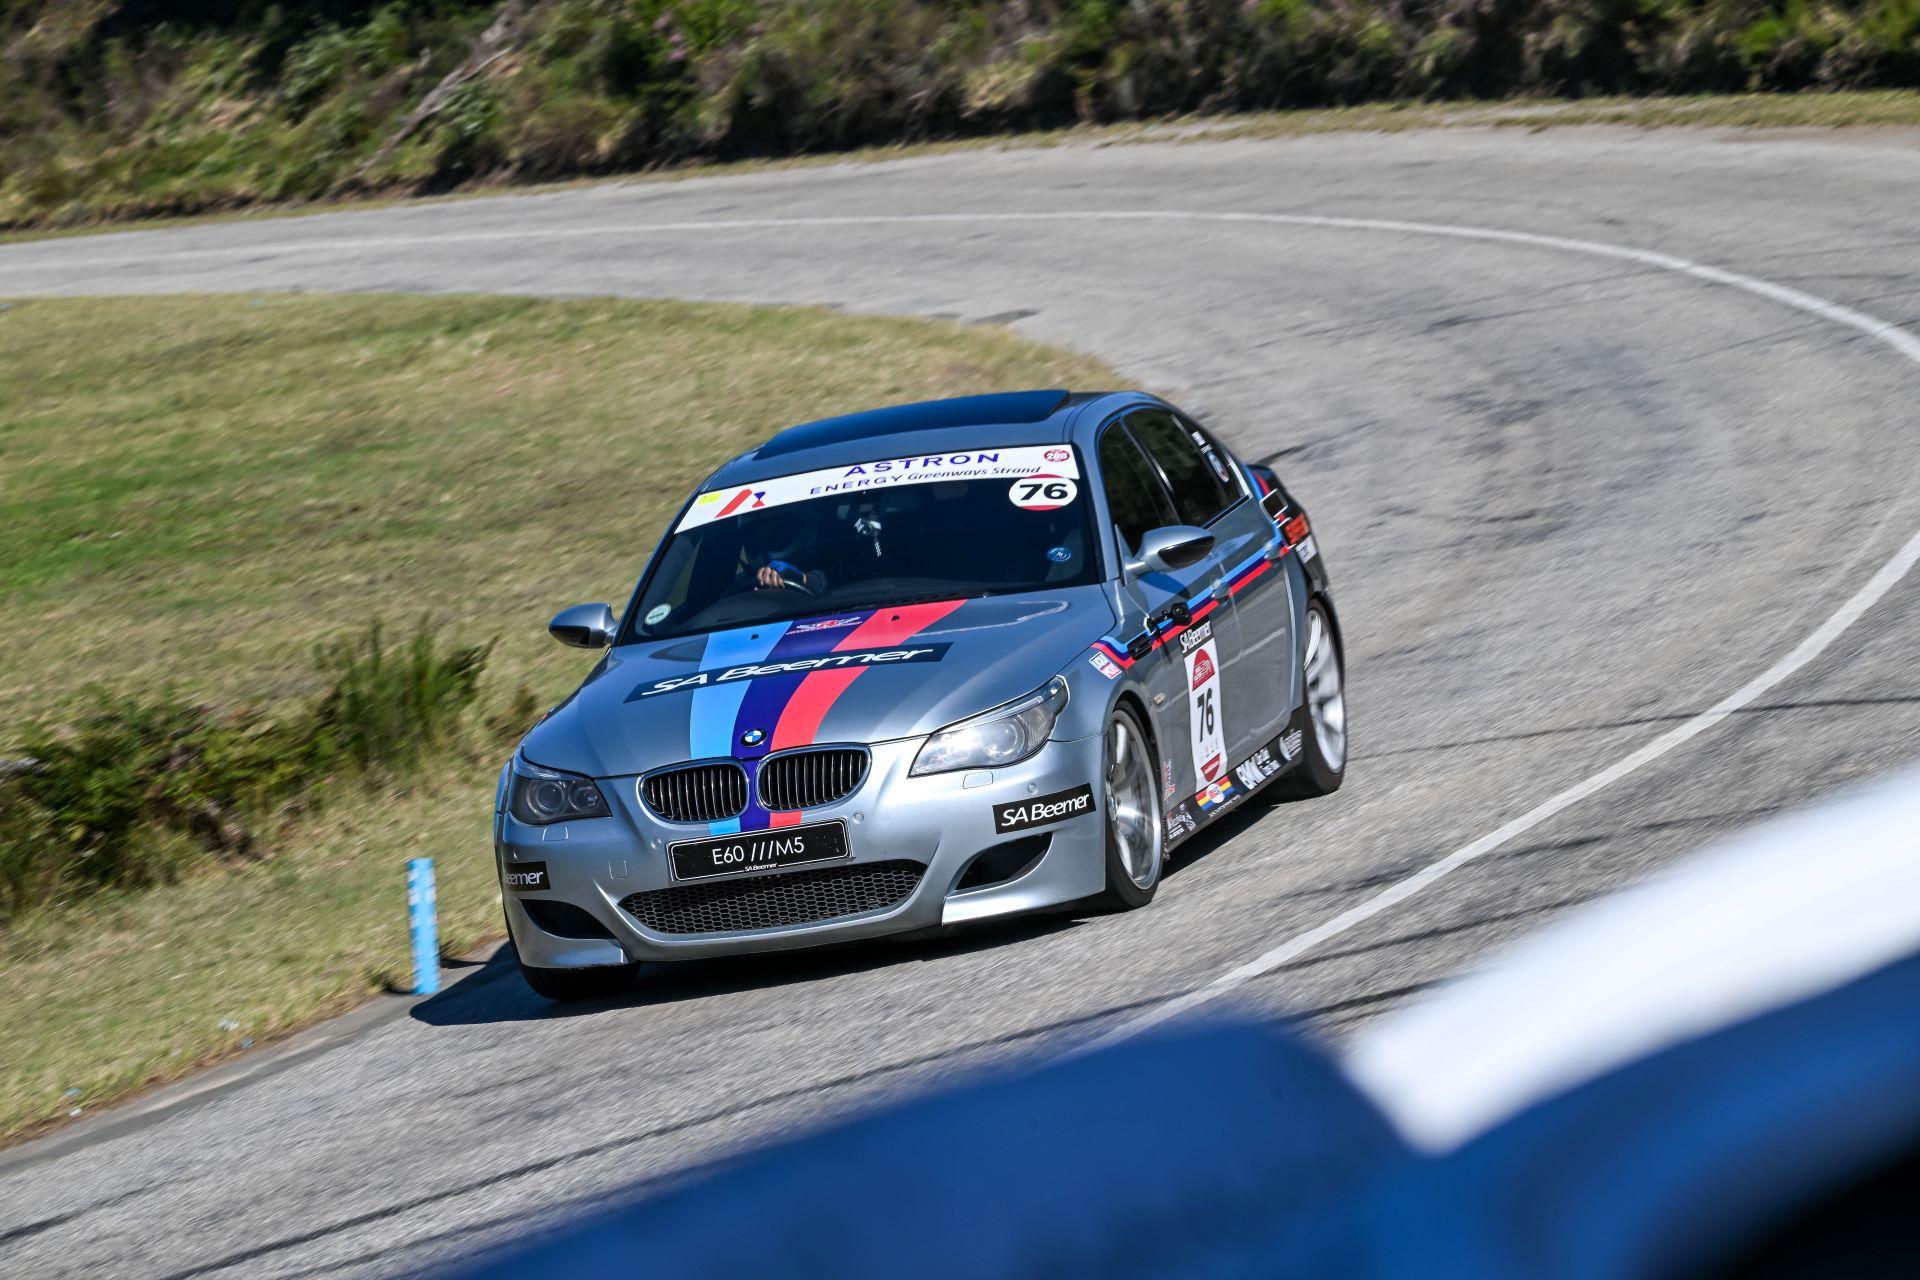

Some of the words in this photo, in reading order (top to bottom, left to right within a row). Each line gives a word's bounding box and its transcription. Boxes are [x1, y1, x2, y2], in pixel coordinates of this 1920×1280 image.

[843, 453, 999, 478] ASTRON
[809, 474, 903, 494] ENERGY
[907, 469, 988, 481] Greenways
[992, 466, 1042, 475] Strand
[1018, 483, 1069, 502] 76
[642, 674, 707, 695] SA
[716, 648, 934, 682] Beemer
[1197, 688, 1214, 743] 76
[1001, 807, 1029, 827] SA
[1031, 794, 1090, 821] Beemer
[712, 845, 745, 865] E60
